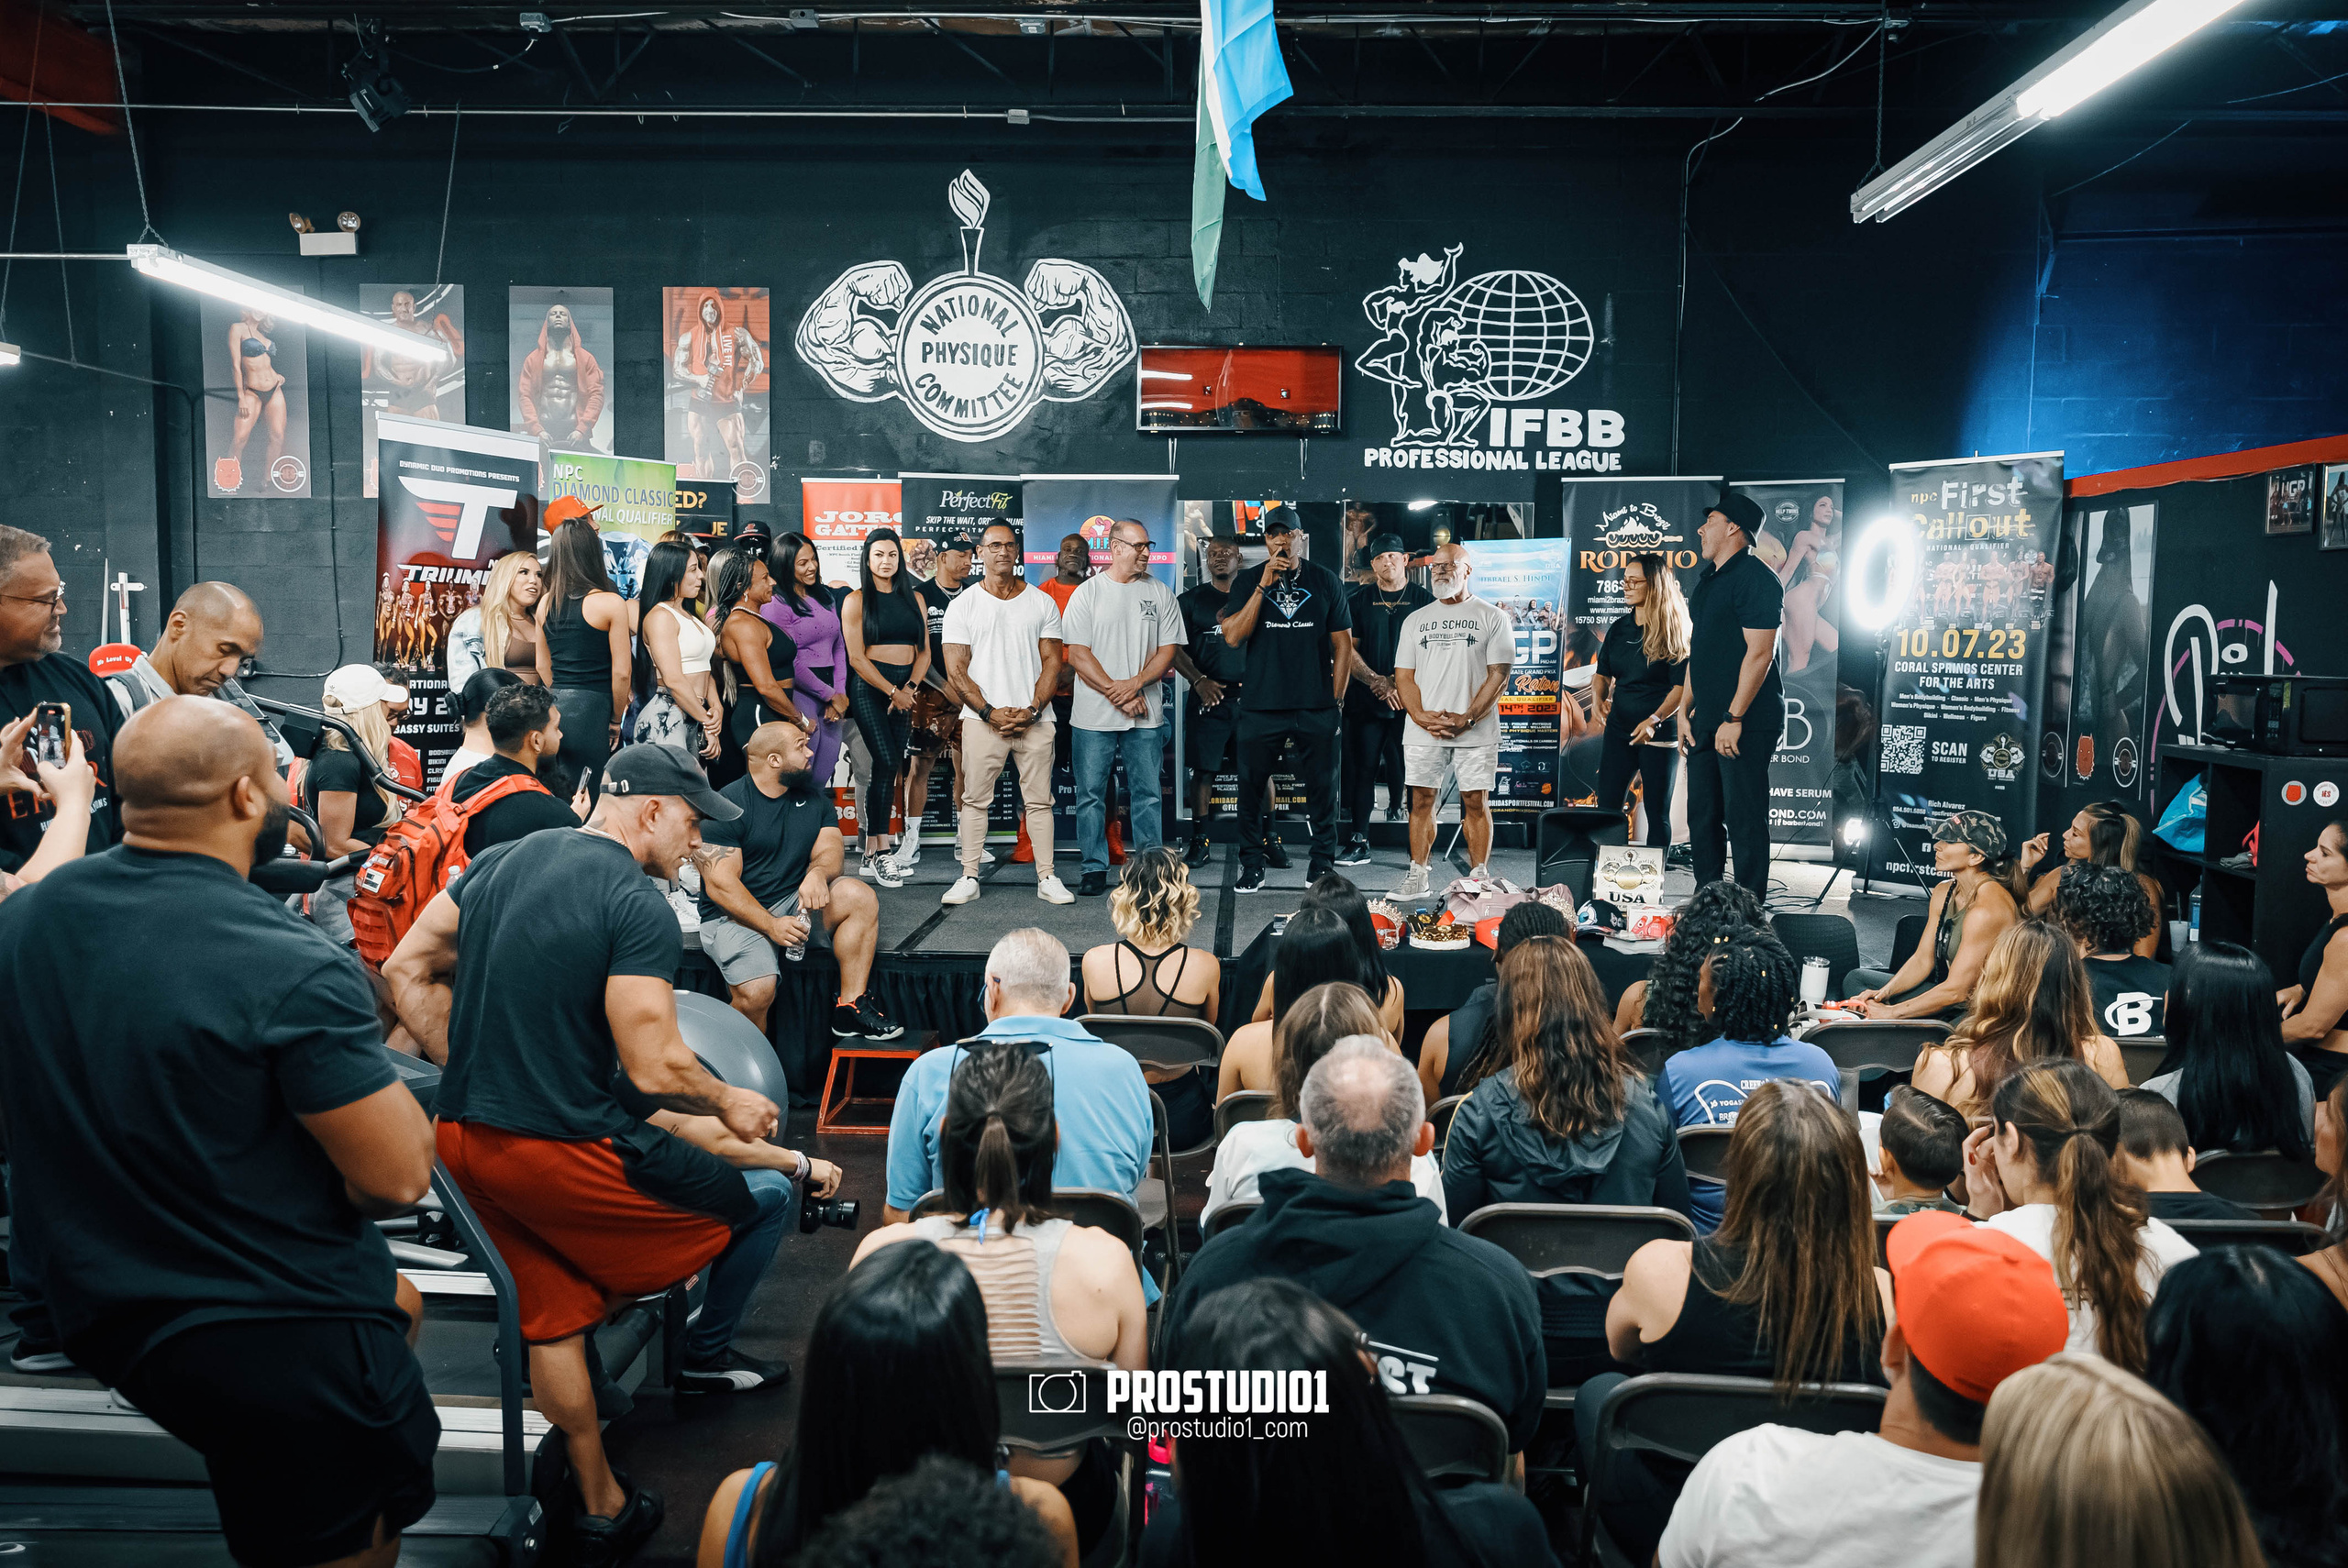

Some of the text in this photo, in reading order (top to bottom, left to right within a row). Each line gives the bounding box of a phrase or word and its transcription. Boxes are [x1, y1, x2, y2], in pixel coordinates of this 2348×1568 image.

[919, 294, 1020, 338] NATIONAL
[722, 335, 732, 354] LIVE
[922, 340, 1018, 368] PHYSIQUE
[914, 371, 1024, 419] COMMITTEE
[1489, 407, 1625, 447] IFBB
[1364, 447, 1622, 472] PROFESSIONAL LEAGUE
[399, 459, 520, 482] DYNAMIC DUO PROMOTIONS PRESENTS
[553, 463, 583, 481] NPC
[553, 481, 674, 508] DIAMOND CLASSIC
[1911, 476, 2024, 510] npc First
[616, 509, 673, 525] QUALIFIER
[925, 515, 942, 525] SKIP
[943, 516, 956, 525] THE
[957, 516, 976, 526] WAIT,
[978, 517, 996, 525] ORD
[1595, 502, 1671, 532] Miami to Brazil
[1969, 542, 2010, 550] QUALIFIER
[1579, 550, 1698, 573] RODIO
[397, 564, 491, 586] TRIUM
[1419, 619, 1480, 633] OLD SCHOOL
[1512, 630, 1557, 664] GP
[1897, 628, 2027, 659] 10.07.23
[1894, 661, 2023, 676] CORAL SPRINGS CENTER
[1919, 676, 1995, 690] FOR THE ARTS
[1527, 704, 1557, 712] 2023
[426, 723, 460, 734] SUITES
[1932, 741, 1968, 757] SCAN
[1780, 755, 1810, 764] BOND
[1058, 785, 1071, 794] Pro
[1795, 788, 1832, 799] SERUM
[1928, 800, 1966, 810] Rich Alvarez
[1608, 890, 1646, 904] USA
